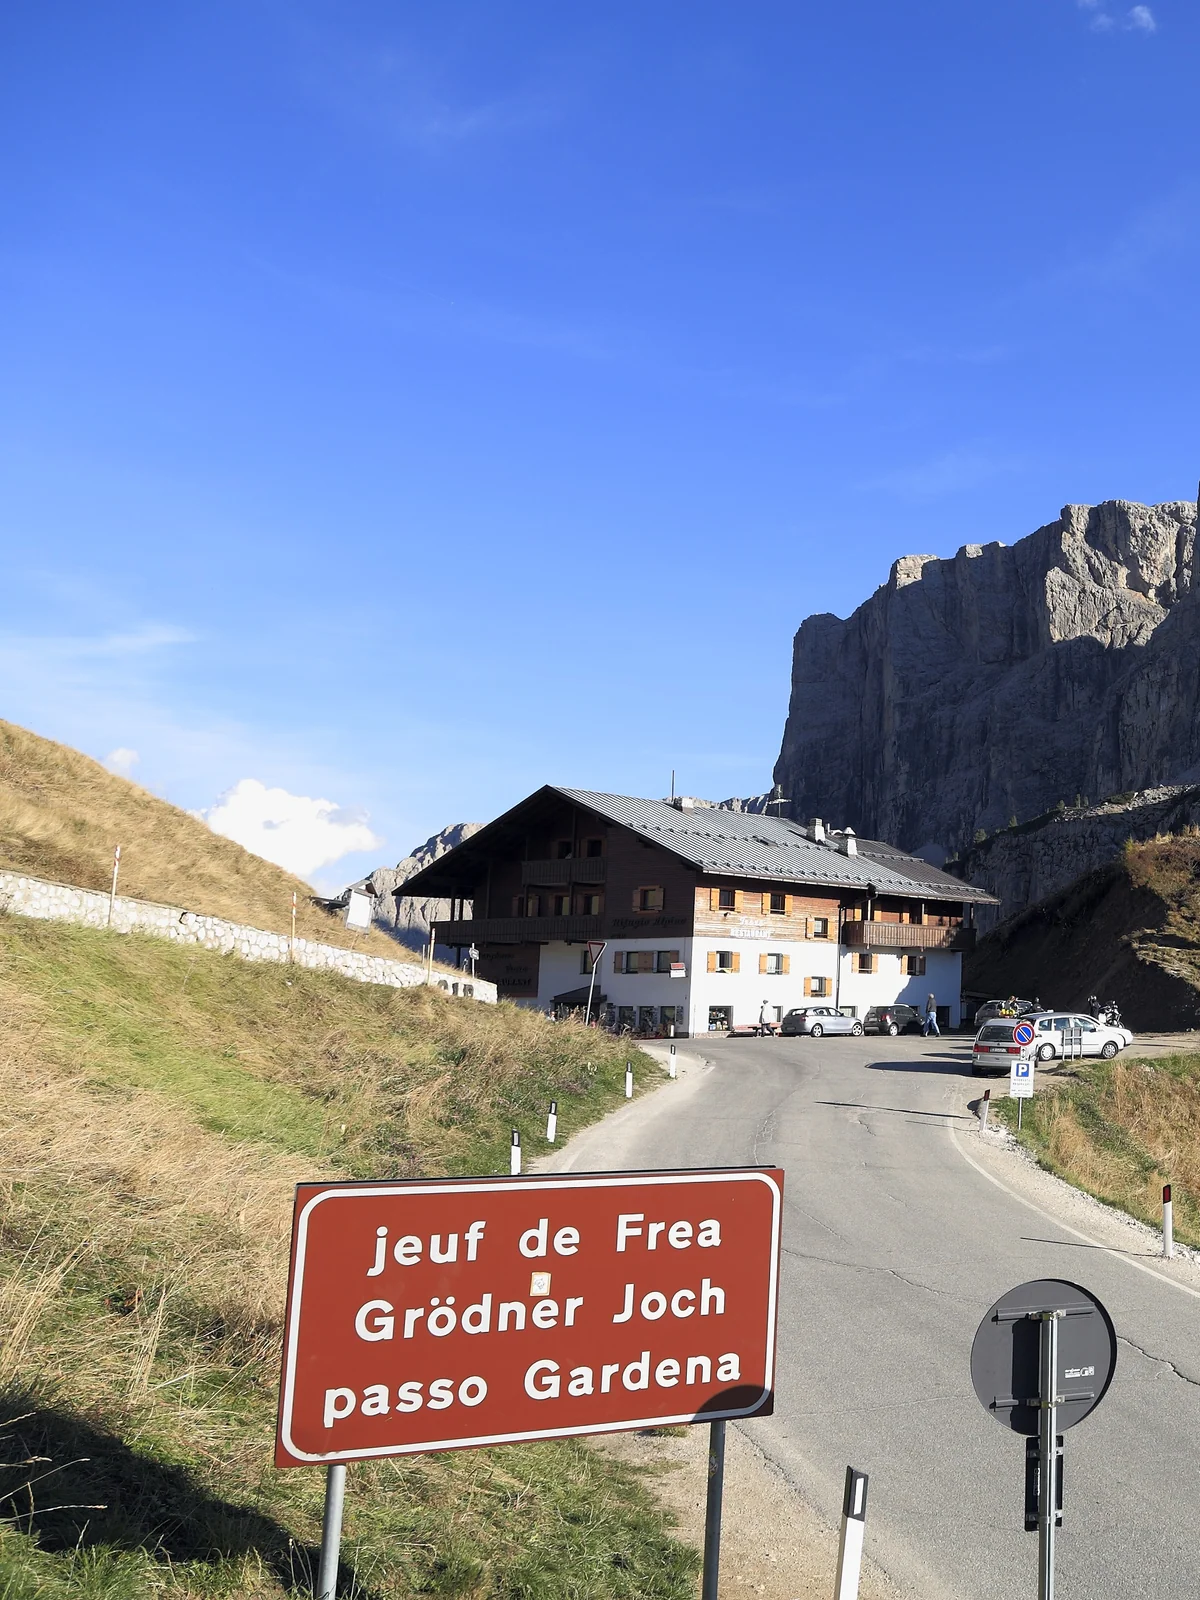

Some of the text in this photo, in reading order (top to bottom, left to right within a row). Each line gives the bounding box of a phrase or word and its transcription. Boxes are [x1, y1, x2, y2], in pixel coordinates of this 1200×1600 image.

[1018, 1064, 1028, 1076] P
[366, 1213, 722, 1277] jeuf de Frea
[354, 1278, 726, 1342] Grödner Joch
[323, 1352, 741, 1429] passo Gardena
